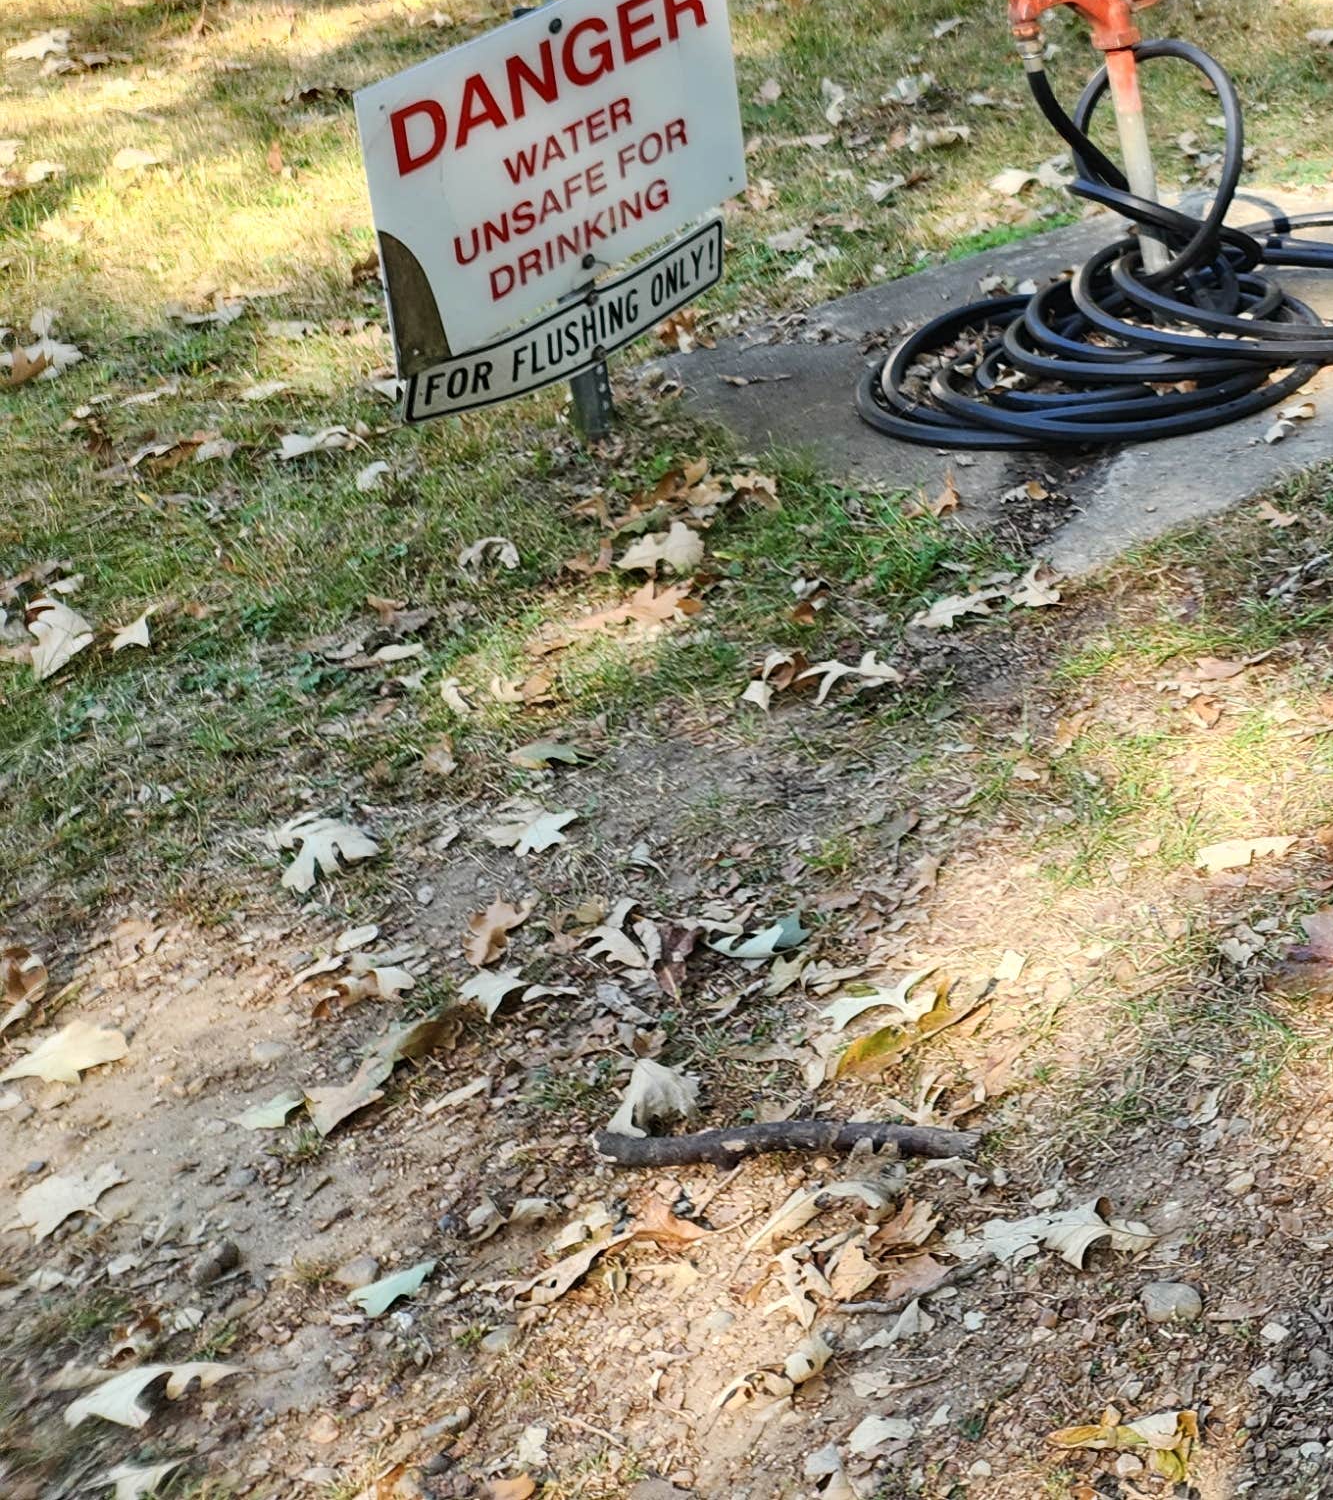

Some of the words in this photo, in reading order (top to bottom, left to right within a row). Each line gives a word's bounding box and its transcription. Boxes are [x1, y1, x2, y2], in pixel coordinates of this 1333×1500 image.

[454, 161, 605, 266] UNSAFE
[617, 117, 688, 178] FOR
[503, 97, 632, 185] WATER
[490, 179, 669, 301] DRINKING
[424, 361, 493, 405] FOR
[512, 289, 639, 382] FLUSHING
[651, 238, 716, 309] ONLY!
